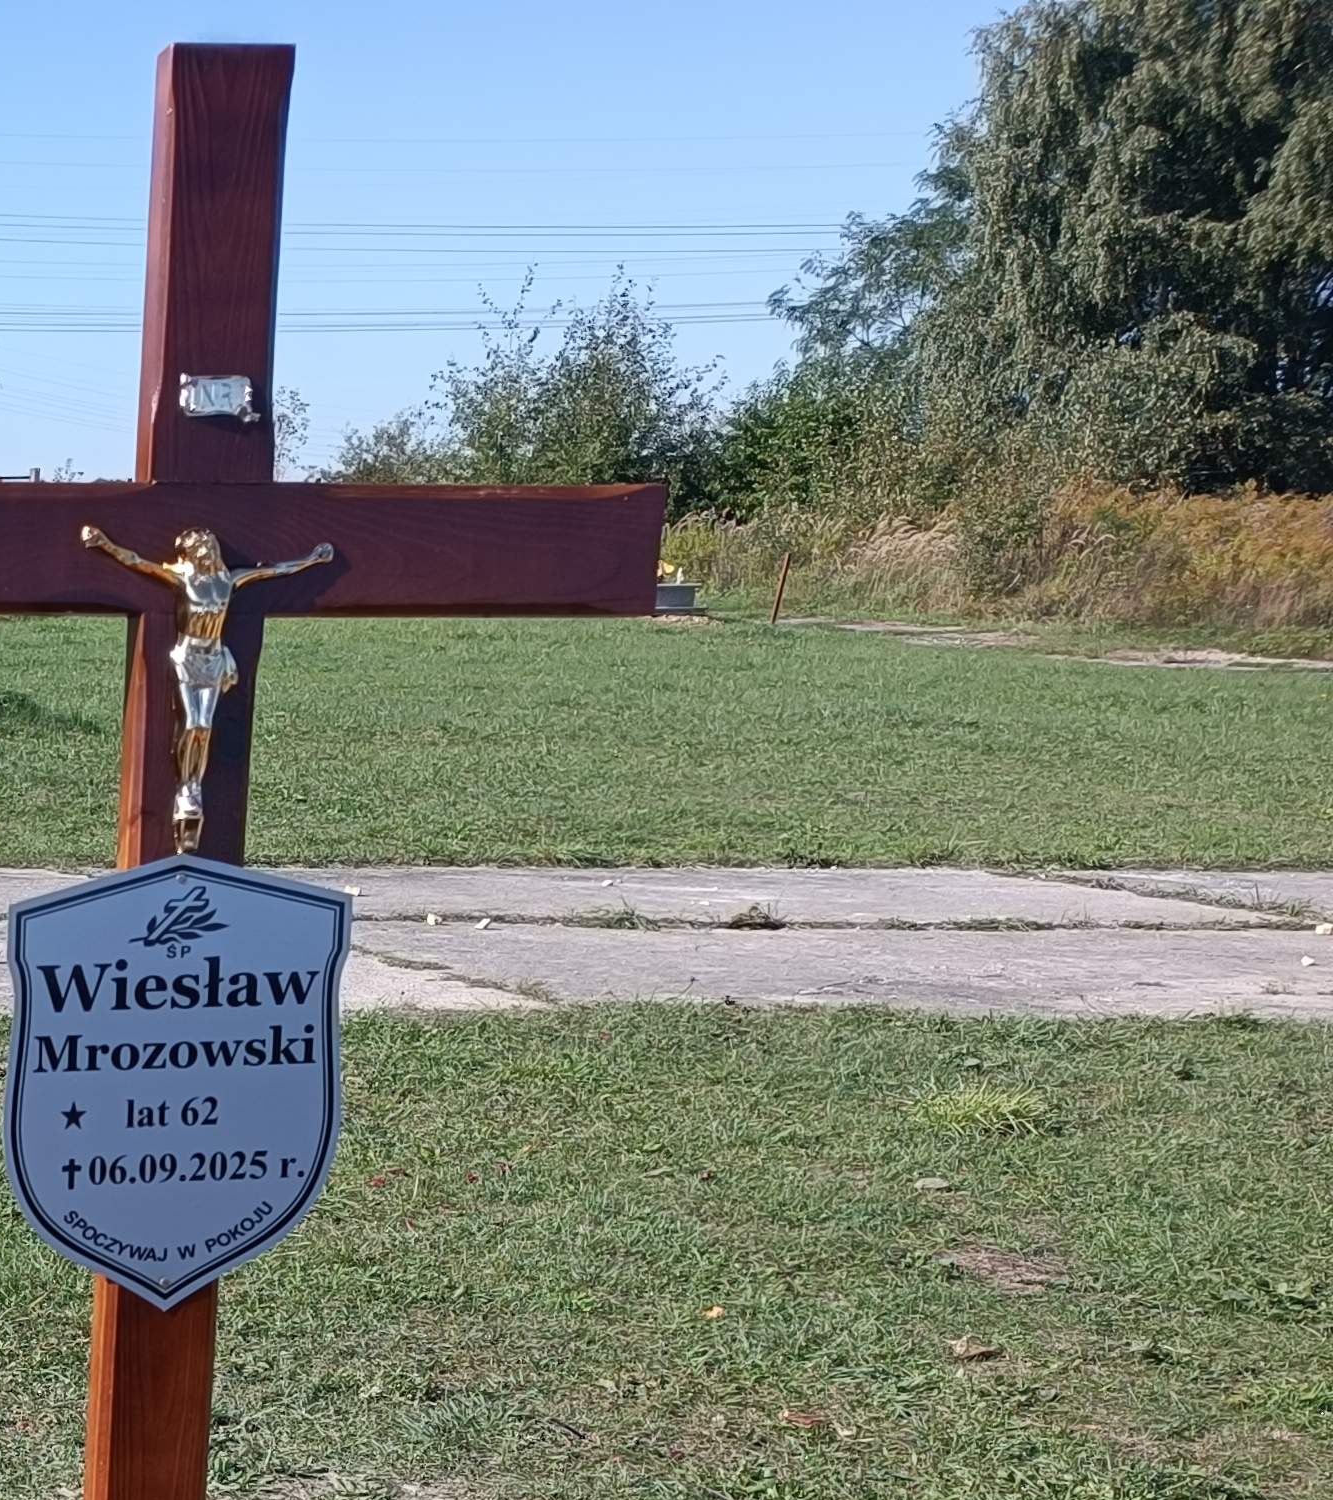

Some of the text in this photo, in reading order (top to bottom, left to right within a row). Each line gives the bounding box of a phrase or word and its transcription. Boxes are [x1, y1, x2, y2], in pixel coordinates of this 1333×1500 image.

[36, 956, 320, 1013] Wiesław
[33, 1024, 317, 1073] Mrozowski
[126, 1096, 218, 1128] lat 62
[89, 1150, 305, 1185] 06.09.2025 r.
[64, 1201, 273, 1262] SPOCZYWAJ W POKOJU
